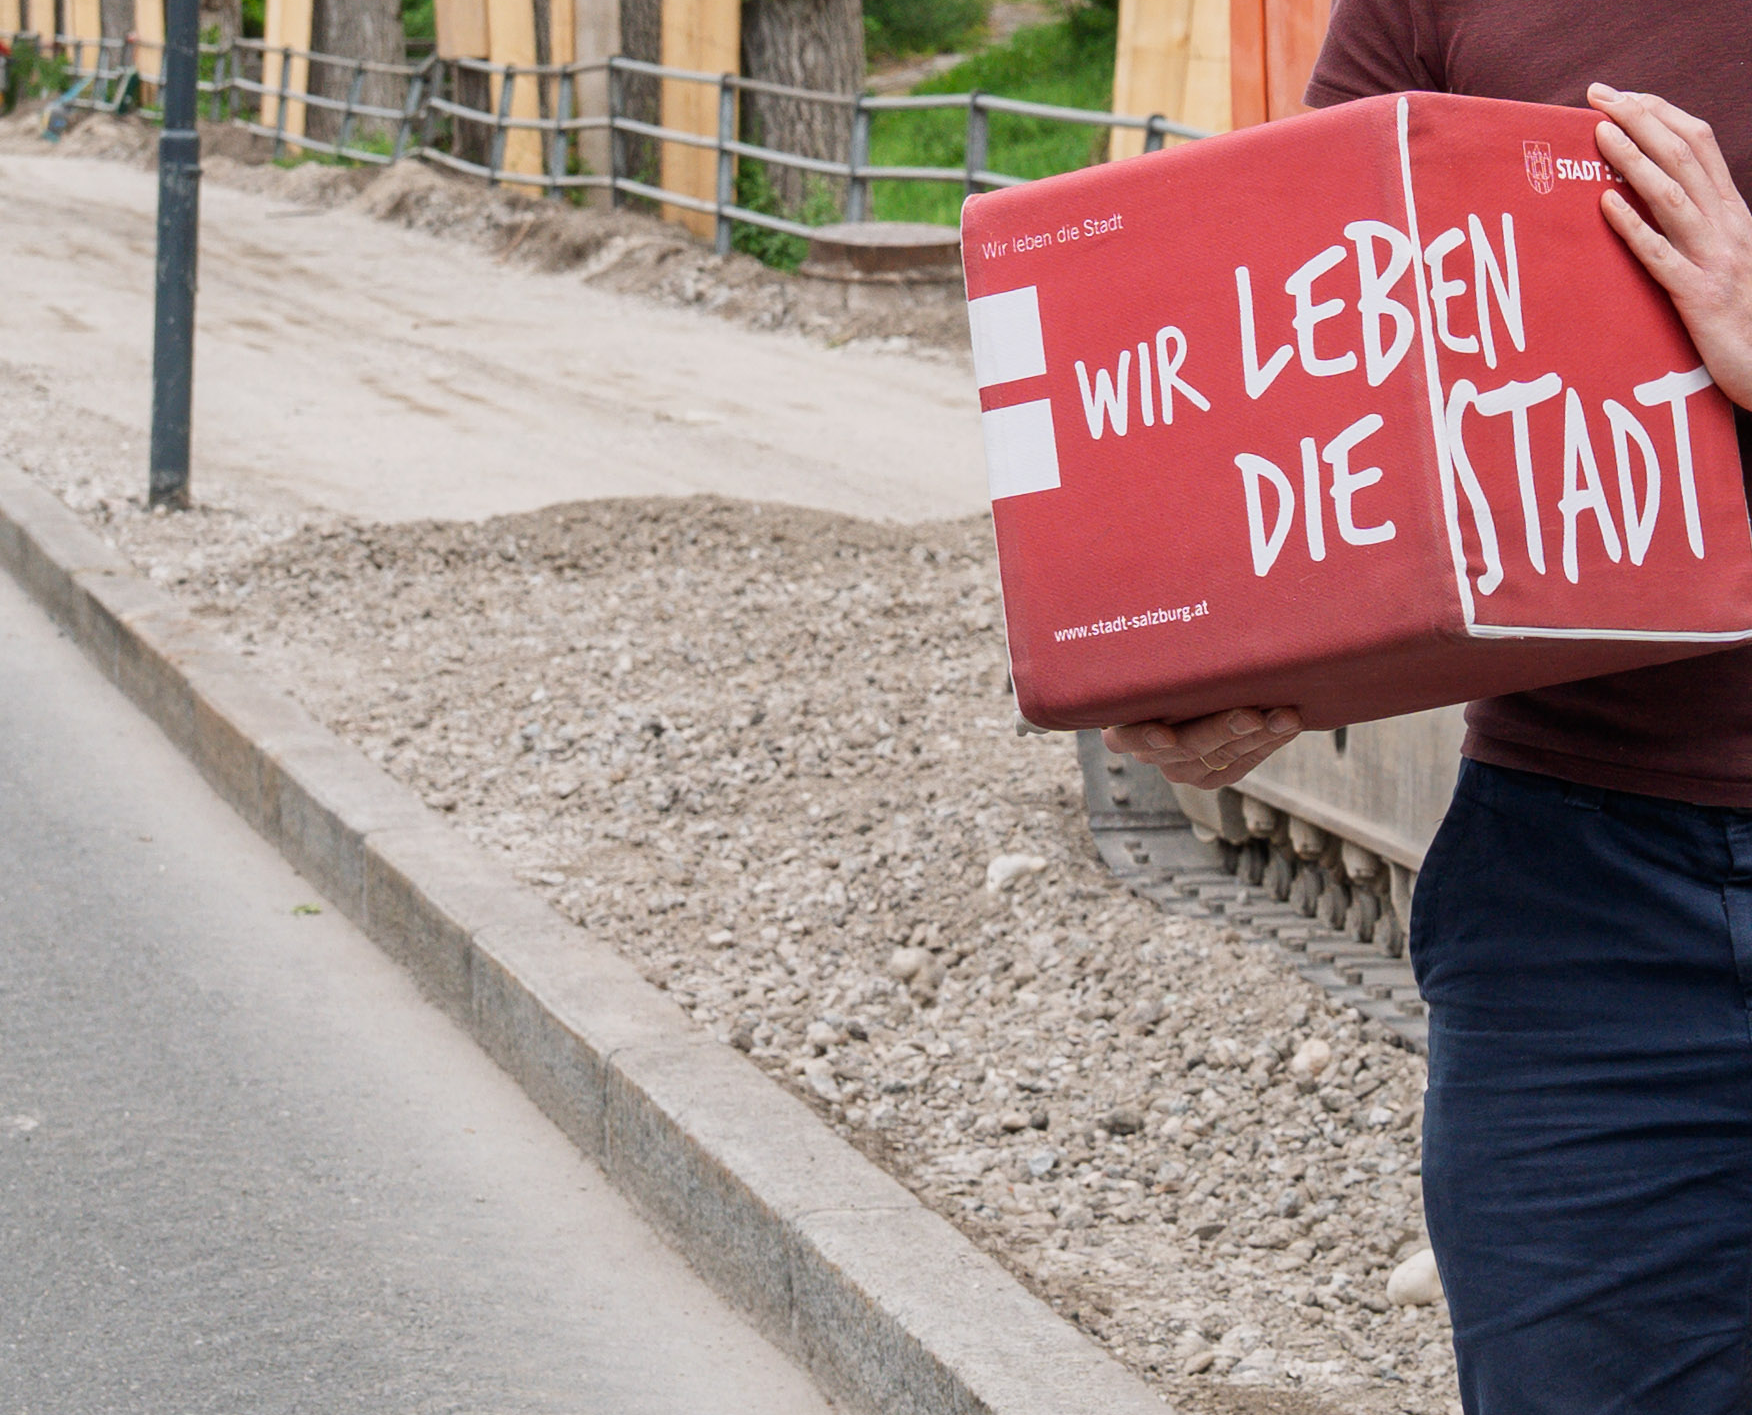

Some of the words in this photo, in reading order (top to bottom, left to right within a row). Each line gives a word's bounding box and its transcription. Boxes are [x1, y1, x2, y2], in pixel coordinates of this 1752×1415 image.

[1555, 157, 1602, 182] STADT
[981, 240, 1009, 260] Wir
[1012, 232, 1053, 253] leben
[1056, 224, 1080, 244] die
[1082, 213, 1125, 238] Stadt
[1074, 325, 1212, 441] WIR
[1233, 212, 1526, 400] LEBEN
[1233, 413, 1397, 578] DIE
[1445, 368, 1714, 596] STADT
[1053, 599, 1210, 643] www.stadt-salzburg.at
